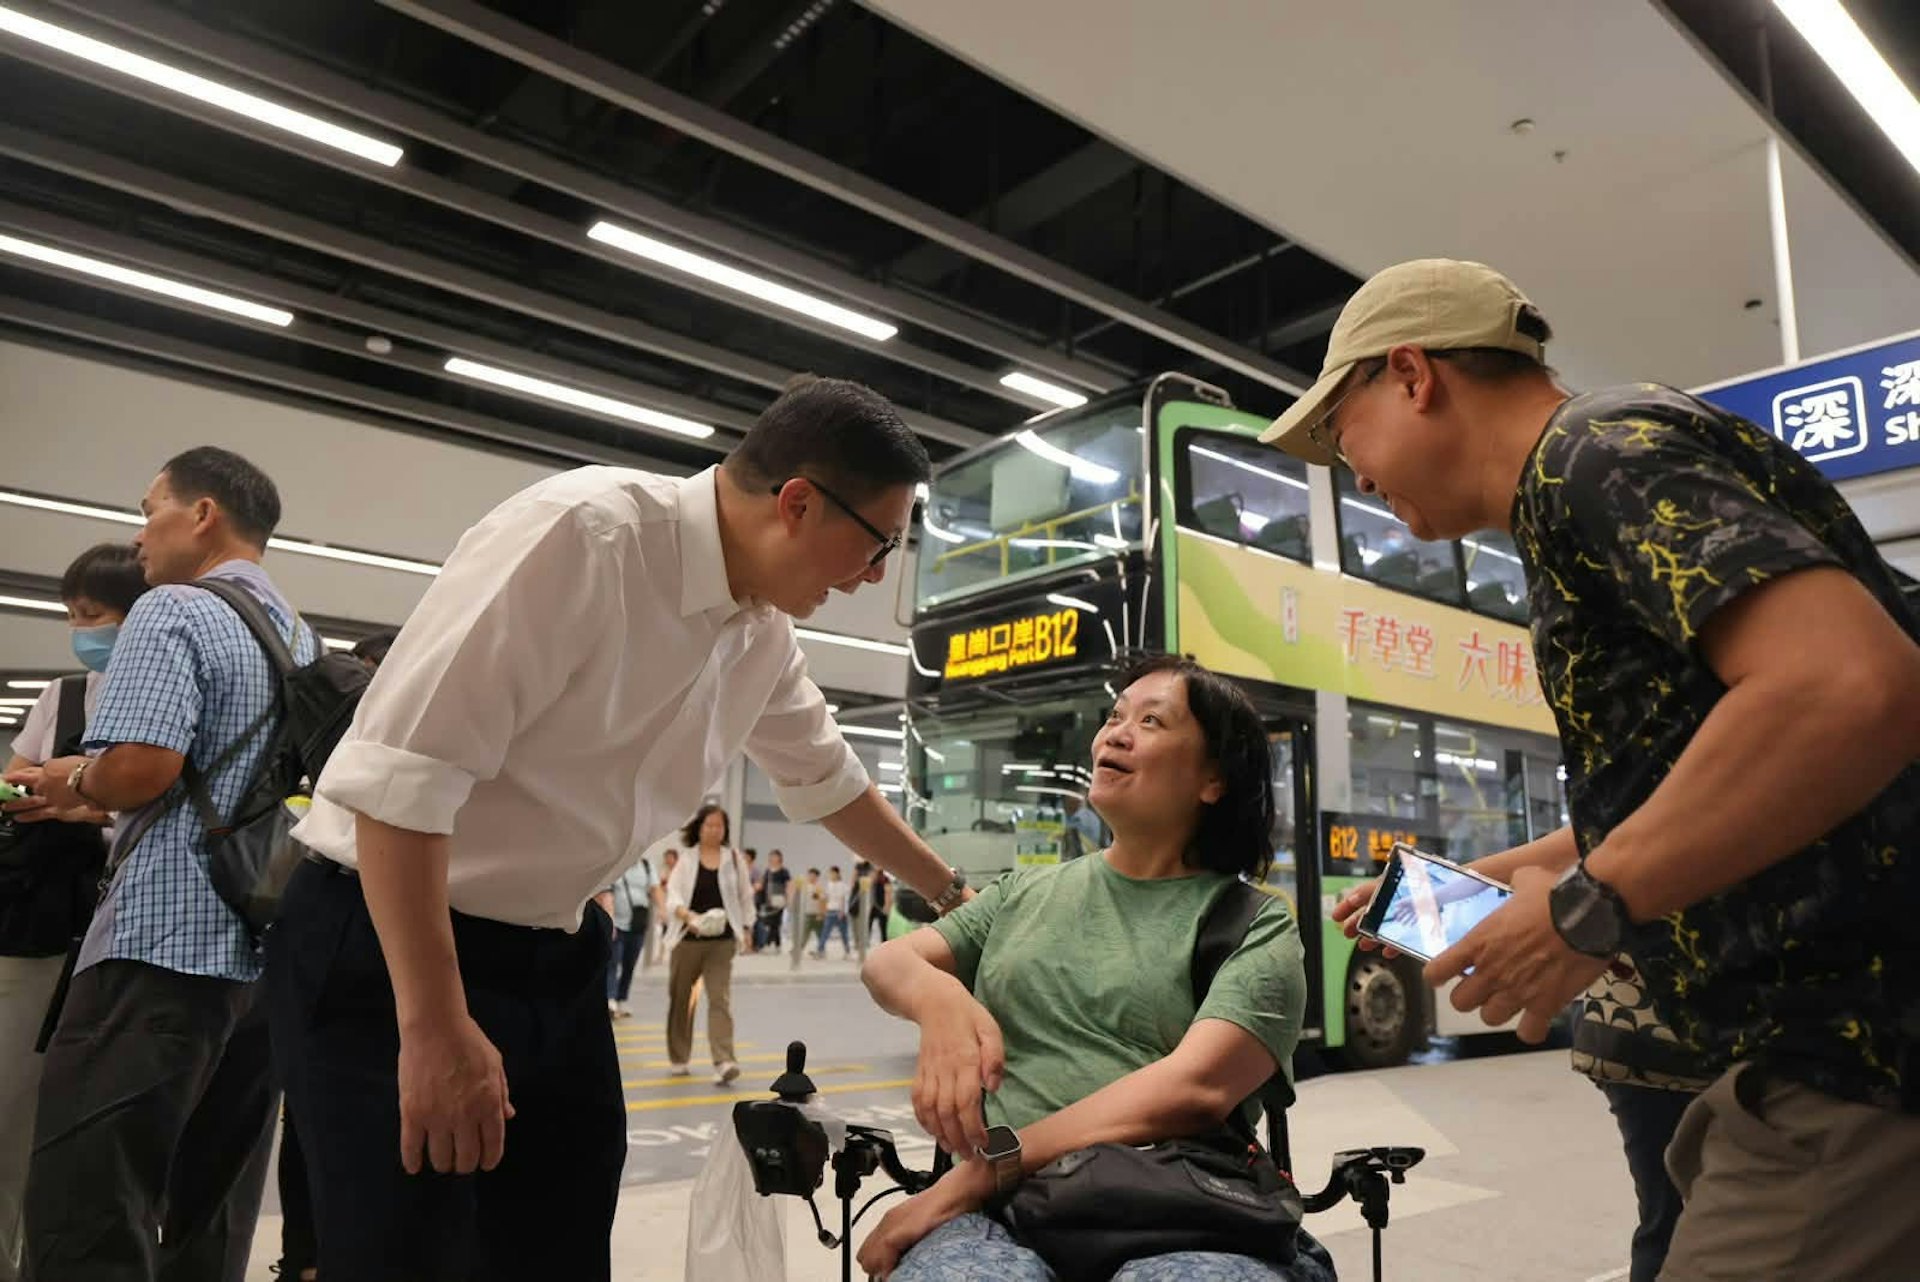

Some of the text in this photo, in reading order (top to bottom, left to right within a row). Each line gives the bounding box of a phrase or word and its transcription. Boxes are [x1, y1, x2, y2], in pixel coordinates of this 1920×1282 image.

[1785, 390, 1854, 450] 深
[1034, 607, 1078, 662] B12
[1459, 630, 1543, 705] 六味
[1330, 825, 1359, 860] B12
